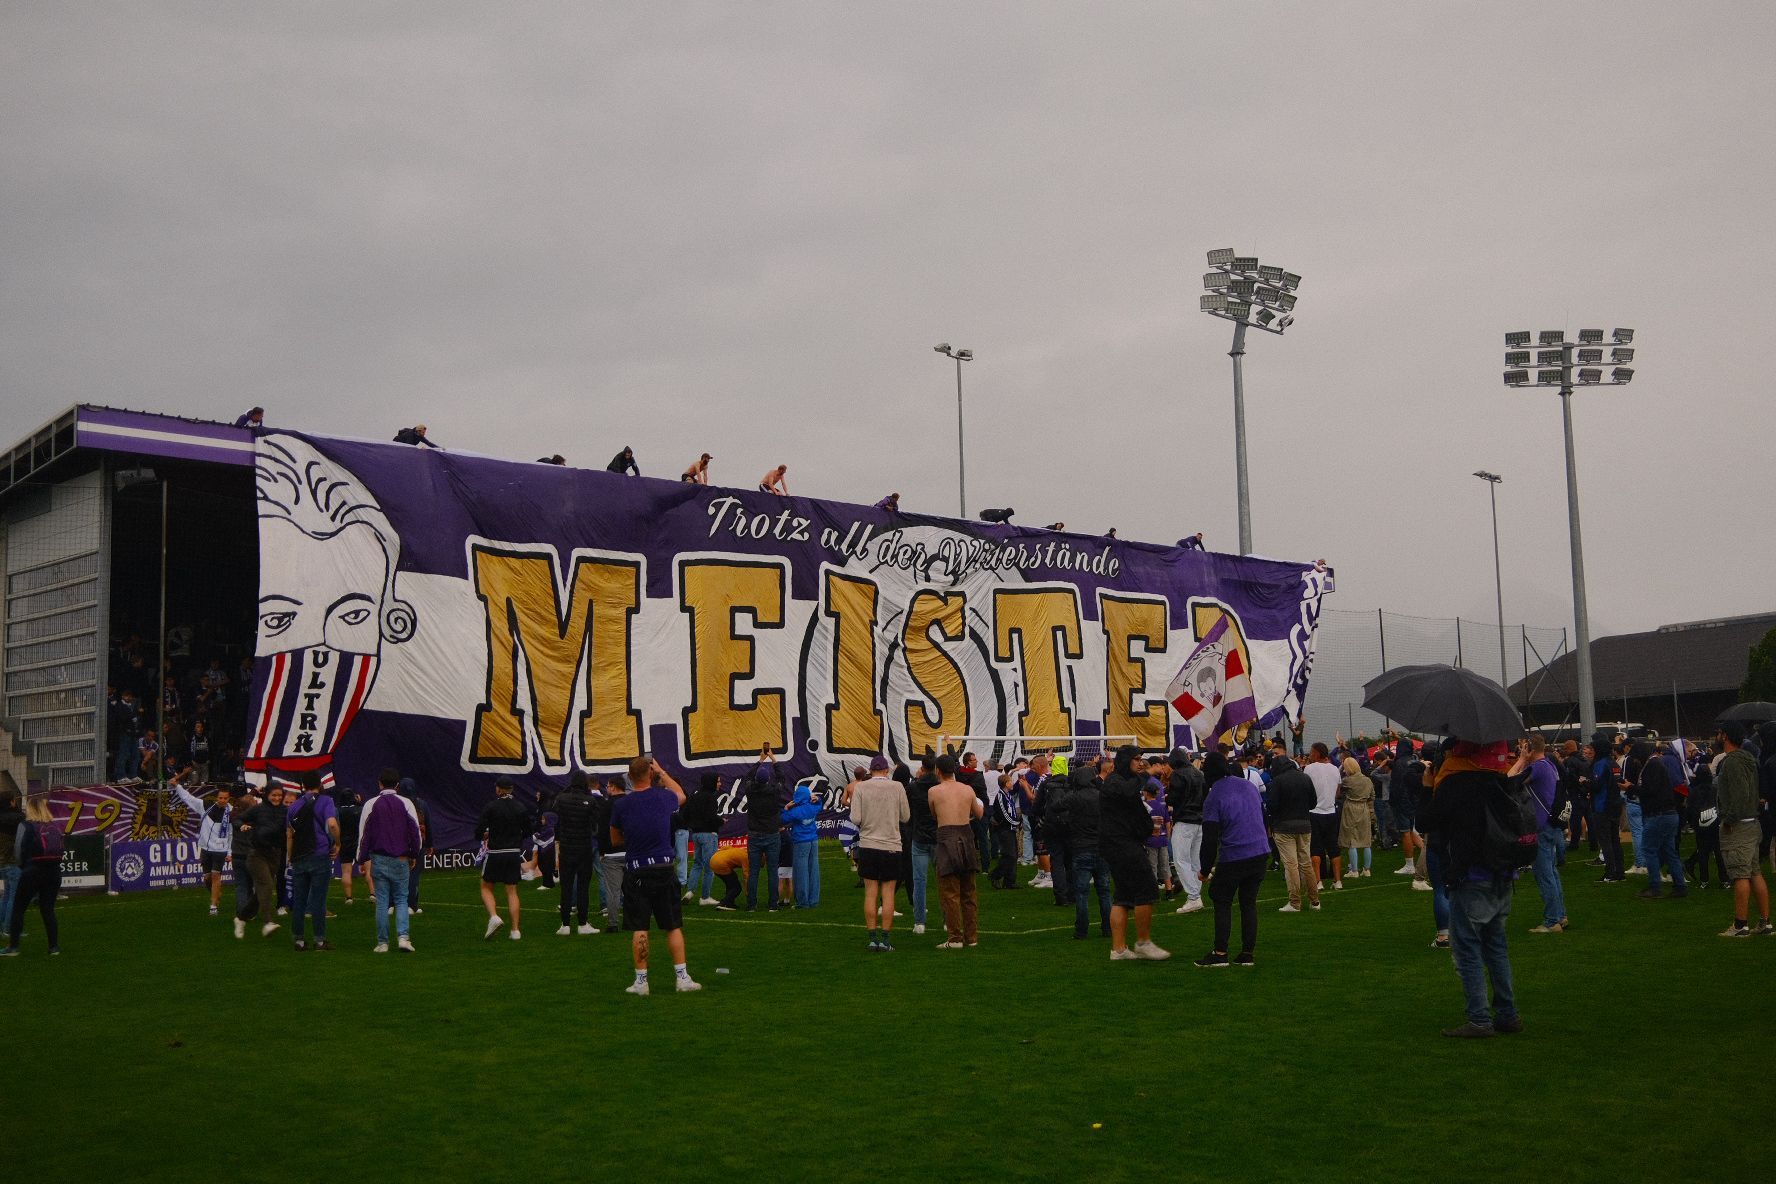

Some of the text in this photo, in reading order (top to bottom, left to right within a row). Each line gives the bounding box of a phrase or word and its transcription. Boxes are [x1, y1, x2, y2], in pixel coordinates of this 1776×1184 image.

[707, 496, 811, 541] Trotz
[820, 521, 874, 560] all
[877, 530, 928, 572] der
[149, 841, 202, 863] GIOV
[423, 852, 478, 869] ENERGY
[59, 861, 89, 873] SSER
[149, 863, 185, 877] ANWALT
